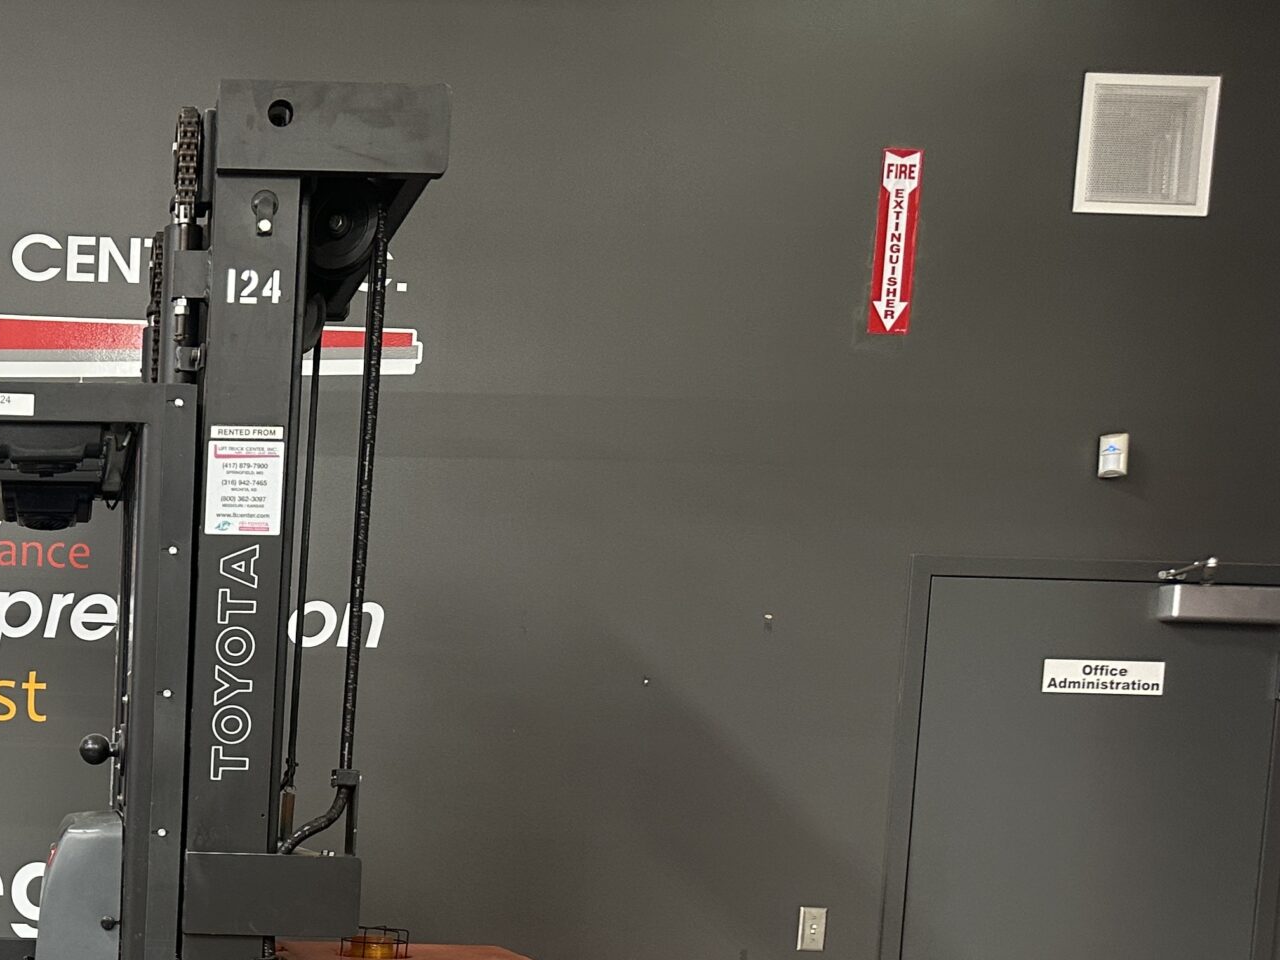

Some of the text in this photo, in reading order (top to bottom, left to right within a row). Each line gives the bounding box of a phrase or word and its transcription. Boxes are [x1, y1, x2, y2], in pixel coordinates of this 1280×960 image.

[886, 164, 917, 180] FIRE
[883, 188, 905, 320] EXTINGUISHER
[226, 268, 282, 304] 124
[210, 544, 261, 781] TOYOTA
[1082, 664, 1128, 677] Office
[1047, 677, 1160, 691] Administration
